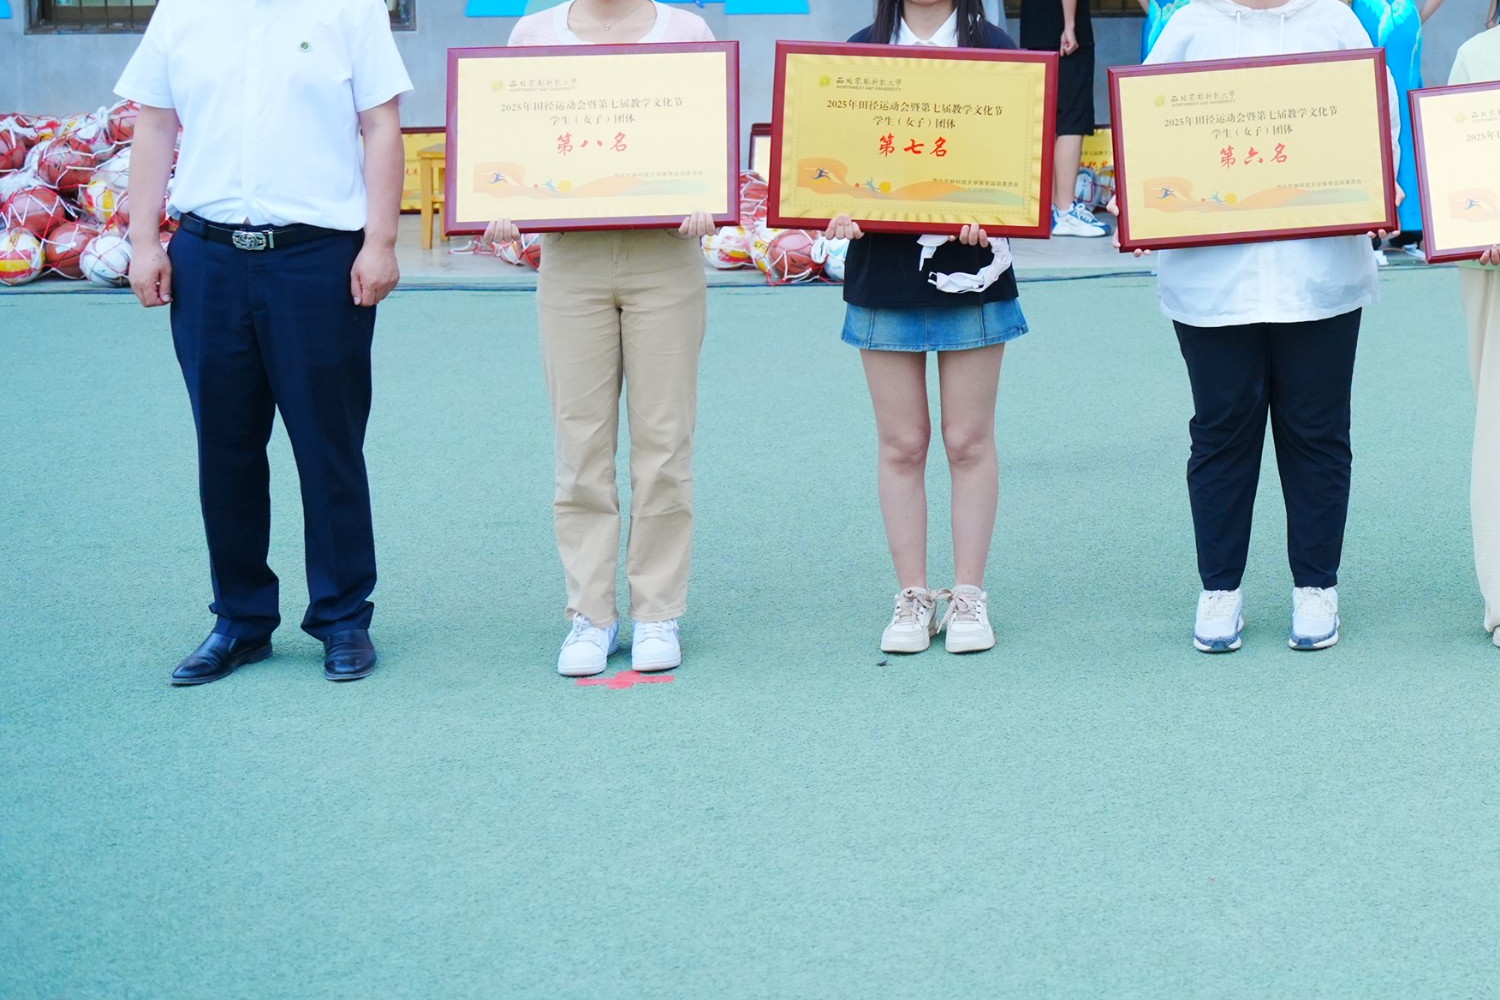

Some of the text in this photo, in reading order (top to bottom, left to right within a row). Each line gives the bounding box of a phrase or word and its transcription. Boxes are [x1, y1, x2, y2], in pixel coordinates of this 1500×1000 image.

[827, 99, 1003, 116] 2025年田径运动会暨第七届教学文化节
[1164, 105, 1338, 127] 2025年田径运动会暨第七届教学文化节
[873, 116, 956, 129] 学生（女子）团体
[1211, 125, 1293, 139] 学生（女子）团体
[556, 131, 628, 156] 第八名
[879, 133, 948, 157] 第七名
[1220, 143, 1288, 169] 第六名
